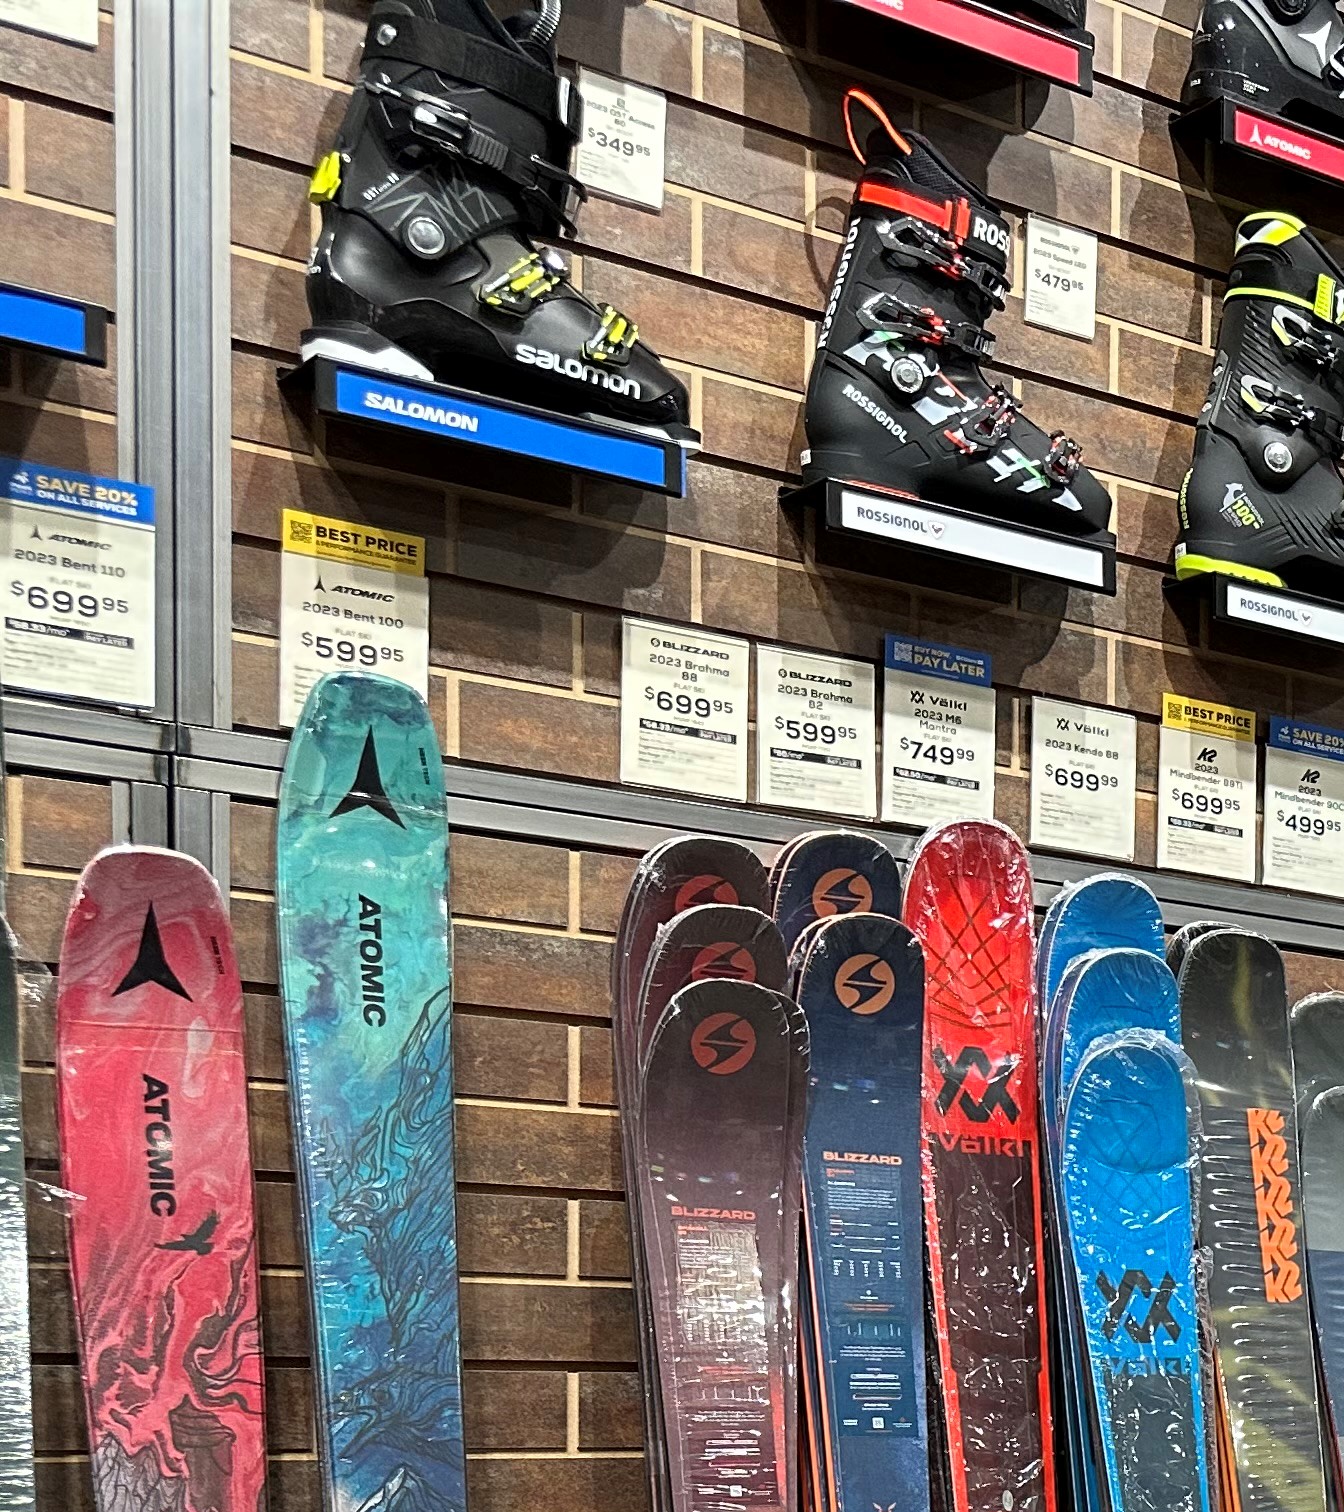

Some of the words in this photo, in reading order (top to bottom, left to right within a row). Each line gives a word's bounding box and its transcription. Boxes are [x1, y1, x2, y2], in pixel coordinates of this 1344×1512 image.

[1263, 135, 1312, 160] ATOMIC
[364, 392, 479, 433] SALOMON
[841, 384, 908, 444] ROSSIGNOL
[34, 475, 91, 498] SAVE
[95, 487, 139, 508] 20%
[36, 489, 56, 502] ON
[57, 492, 81, 506] ALL
[856, 506, 928, 534] ROSSIGNOL
[315, 525, 362, 545] BEST
[365, 535, 418, 558] PRICE
[14, 548, 58, 567] 2023
[60, 556, 98, 575] Bent
[100, 562, 126, 579] 110
[330, 585, 396, 604] ATOMIC
[302, 601, 341, 618] 2023
[343, 609, 376, 625] Bent
[378, 615, 405, 630] 100
[1240, 597, 1299, 622] ROSSIGNOL
[662, 639, 730, 661] BLIZZARD
[648, 652, 682, 671] 2023
[684, 660, 731, 679] Brahma
[913, 653, 938, 669] PAY
[940, 657, 986, 679] LATER
[788, 669, 854, 689] BLIZZARD
[776, 683, 808, 700] 2023
[809, 689, 854, 705] Brahma
[928, 695, 969, 713] Völkl
[913, 707, 943, 720] 2023
[1184, 705, 1214, 722] BEST
[1216, 712, 1252, 729] PRICE
[918, 719, 958, 736] Mantra
[1292, 726, 1323, 744] SAVE
[1045, 737, 1073, 753] 2023
[1196, 747, 1218, 763] K2
[1169, 767, 1221, 787] Mindbender
[1300, 768, 1321, 784] K2
[1274, 790, 1324, 809] Mindbender
[356, 892, 387, 1029] ATOMIC
[141, 1072, 177, 1218] ATOMIC
[938, 1133, 1026, 1160] Völkl
[822, 1149, 903, 1167] BLIZZARD
[671, 1205, 757, 1222] BLIZZARD
